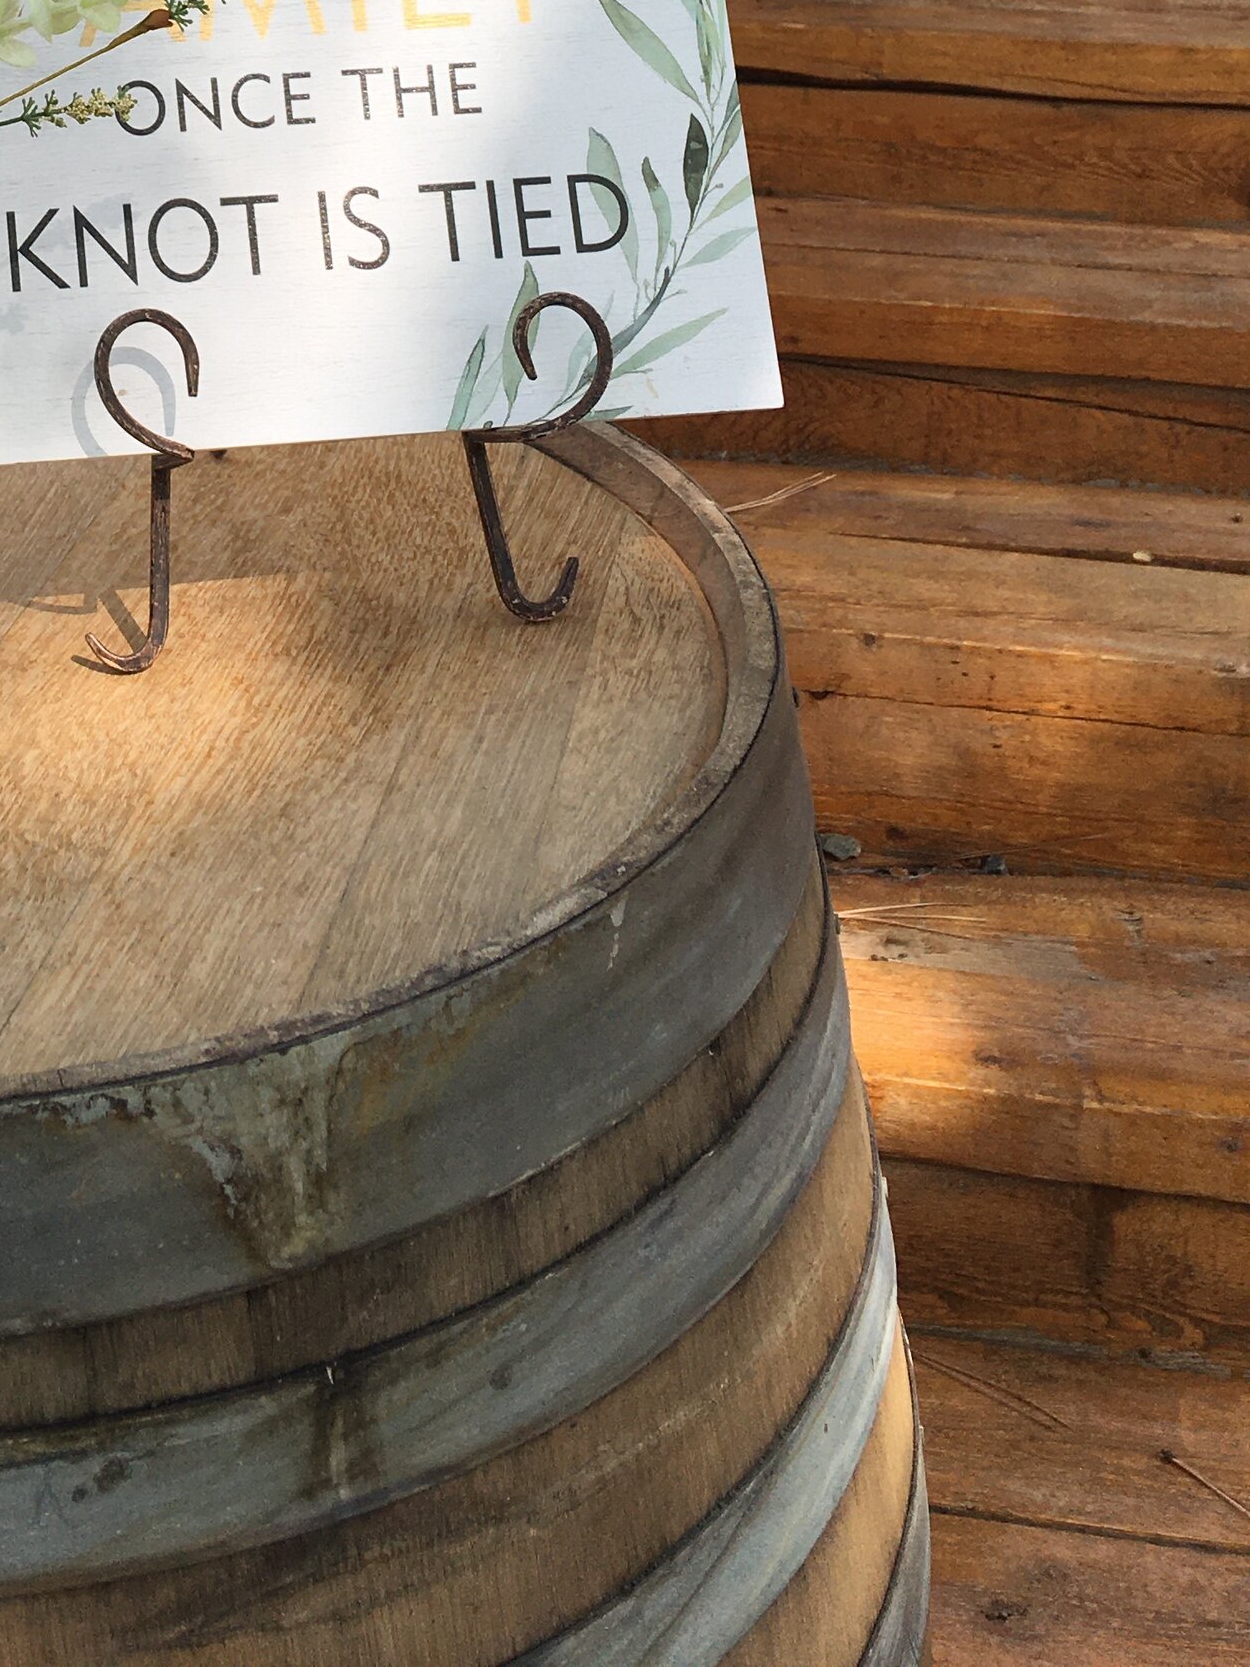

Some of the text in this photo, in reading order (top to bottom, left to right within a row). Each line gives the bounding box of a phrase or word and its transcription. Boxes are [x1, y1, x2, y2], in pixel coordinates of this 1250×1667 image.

[114, 61, 484, 137] ONCE THE
[5, 172, 631, 294] KNOT IS TIED
